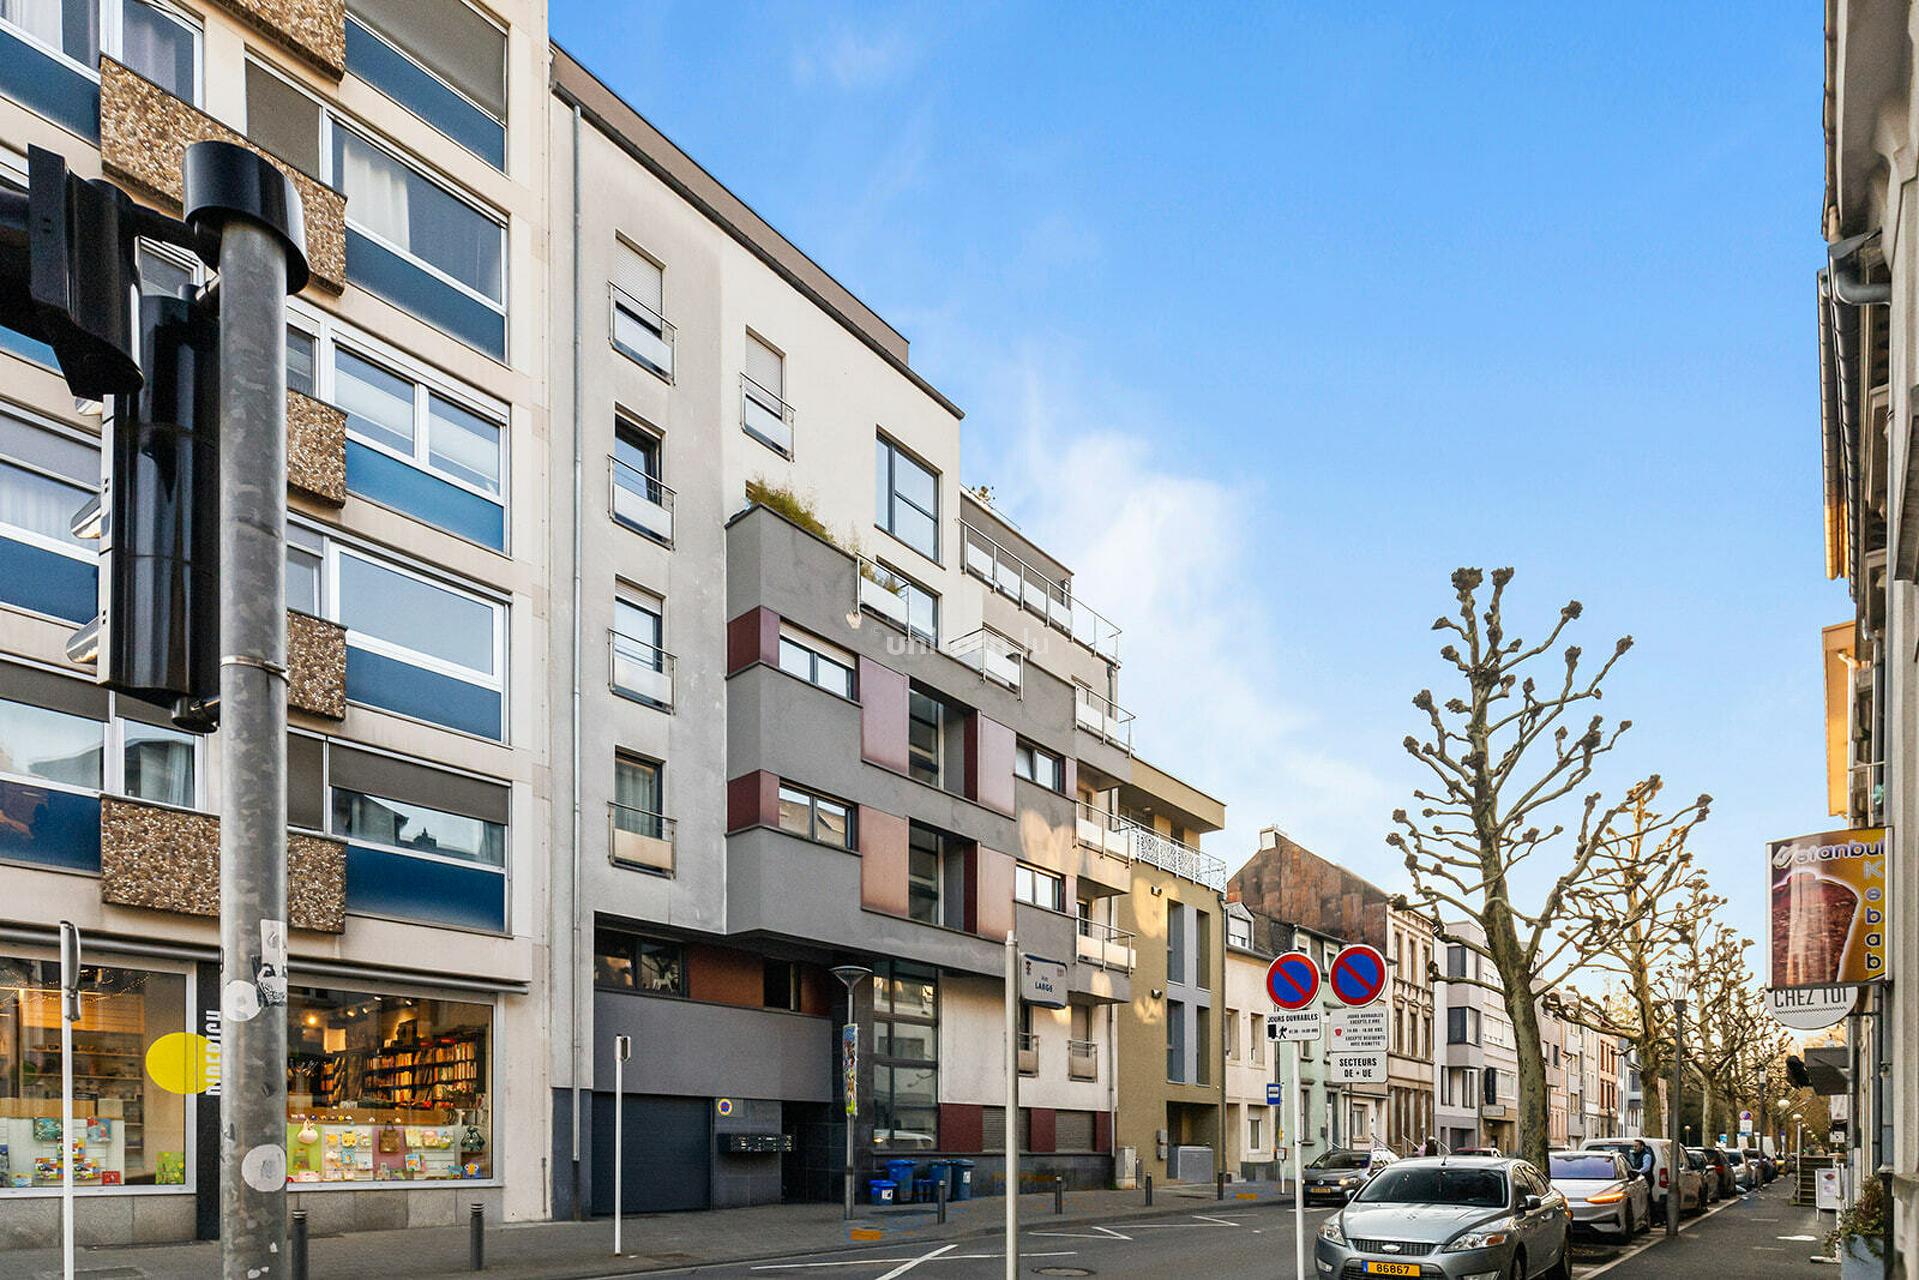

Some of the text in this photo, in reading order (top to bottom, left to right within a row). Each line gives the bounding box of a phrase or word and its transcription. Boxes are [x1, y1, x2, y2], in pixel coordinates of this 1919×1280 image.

[1863, 860, 1884, 970] Kebab
[1774, 989, 1814, 1008] CHEZ
[1824, 987, 1846, 1004] TOI
[1267, 1013, 1318, 1023] JOURS OUVRABLES
[1339, 1058, 1377, 1067] SECTEURS
[1344, 1069, 1354, 1078] DE
[1376, 1263, 1410, 1275] 86867
